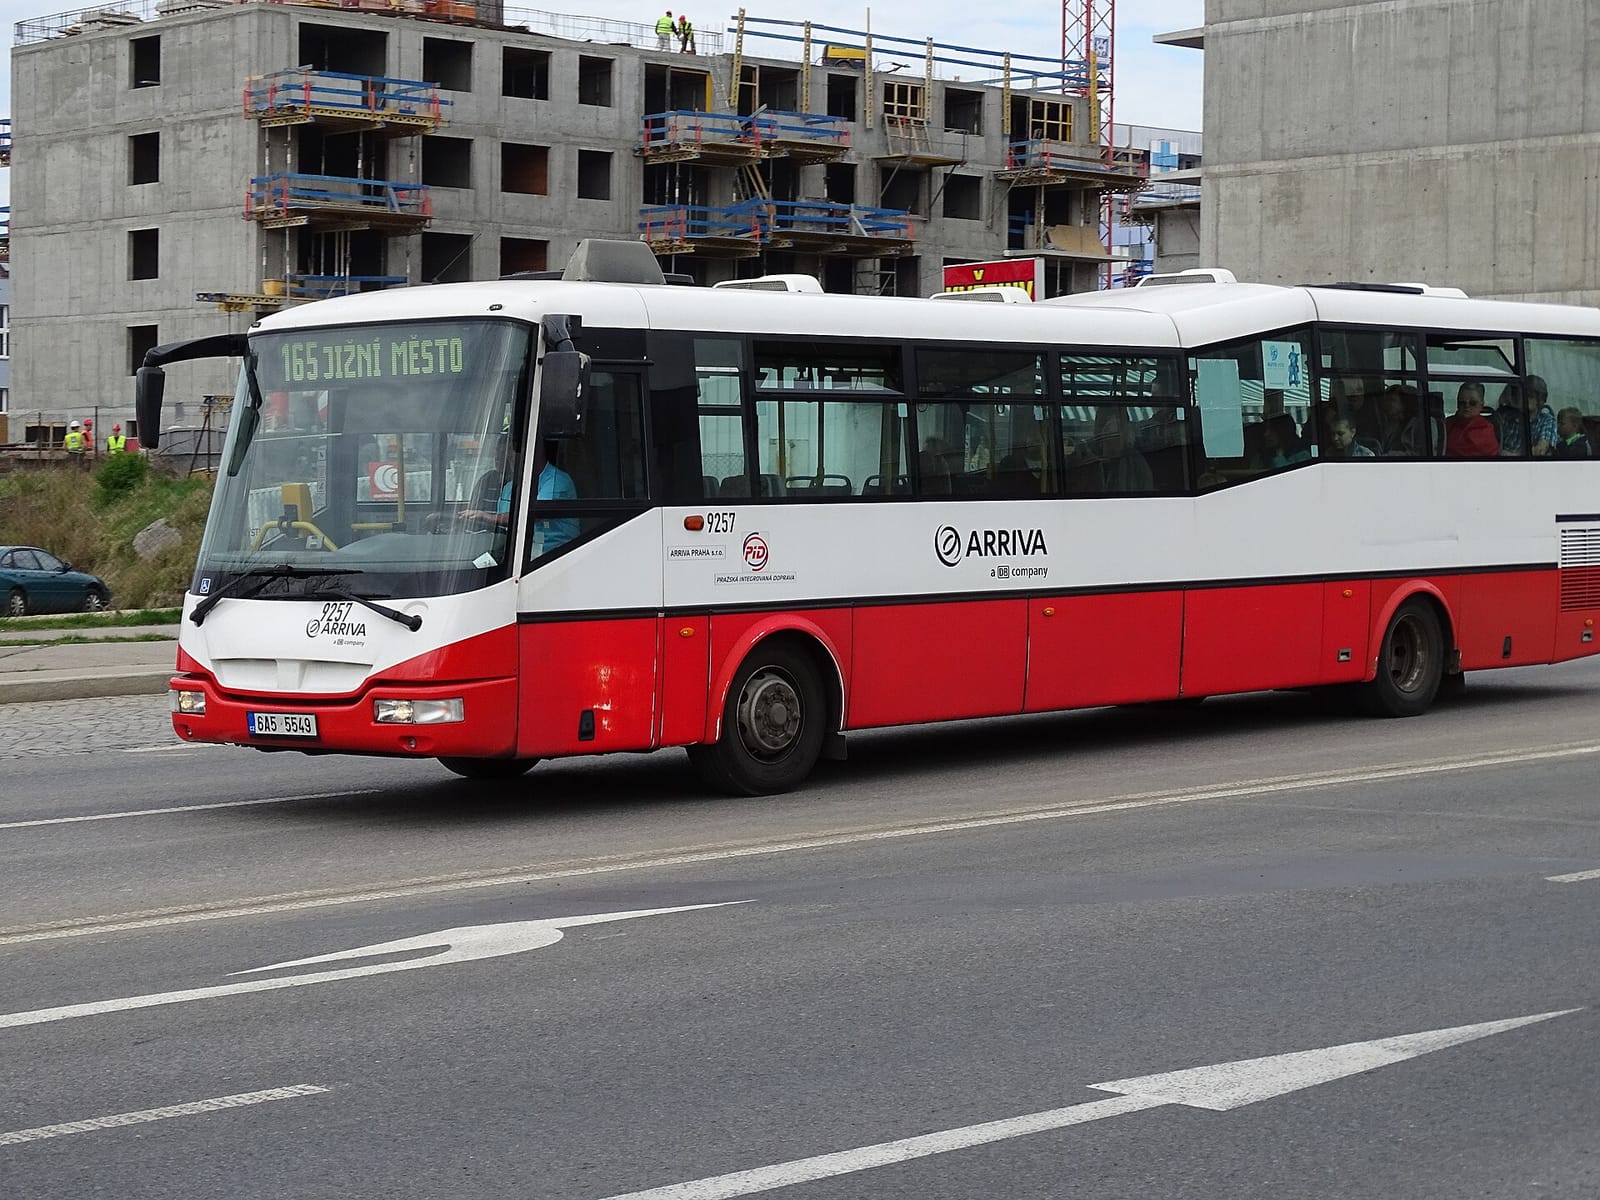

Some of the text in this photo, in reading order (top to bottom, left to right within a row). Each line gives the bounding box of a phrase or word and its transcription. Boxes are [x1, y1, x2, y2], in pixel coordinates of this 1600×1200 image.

[281, 335, 463, 382] 165 JIŽNÍ MĚSTO
[707, 512, 736, 533] 9257
[965, 529, 1048, 557] ARRIVA
[670, 548, 691, 557] ARRIVA
[691, 548, 711, 557] PRAHA
[772, 574, 795, 582] DOPRAVA
[990, 568, 996, 577] a
[1011, 567, 1048, 579] company
[320, 602, 354, 622] 9257
[320, 622, 367, 637] ARRIVA
[257, 715, 278, 732] 6A5
[284, 716, 312, 733] 5549
